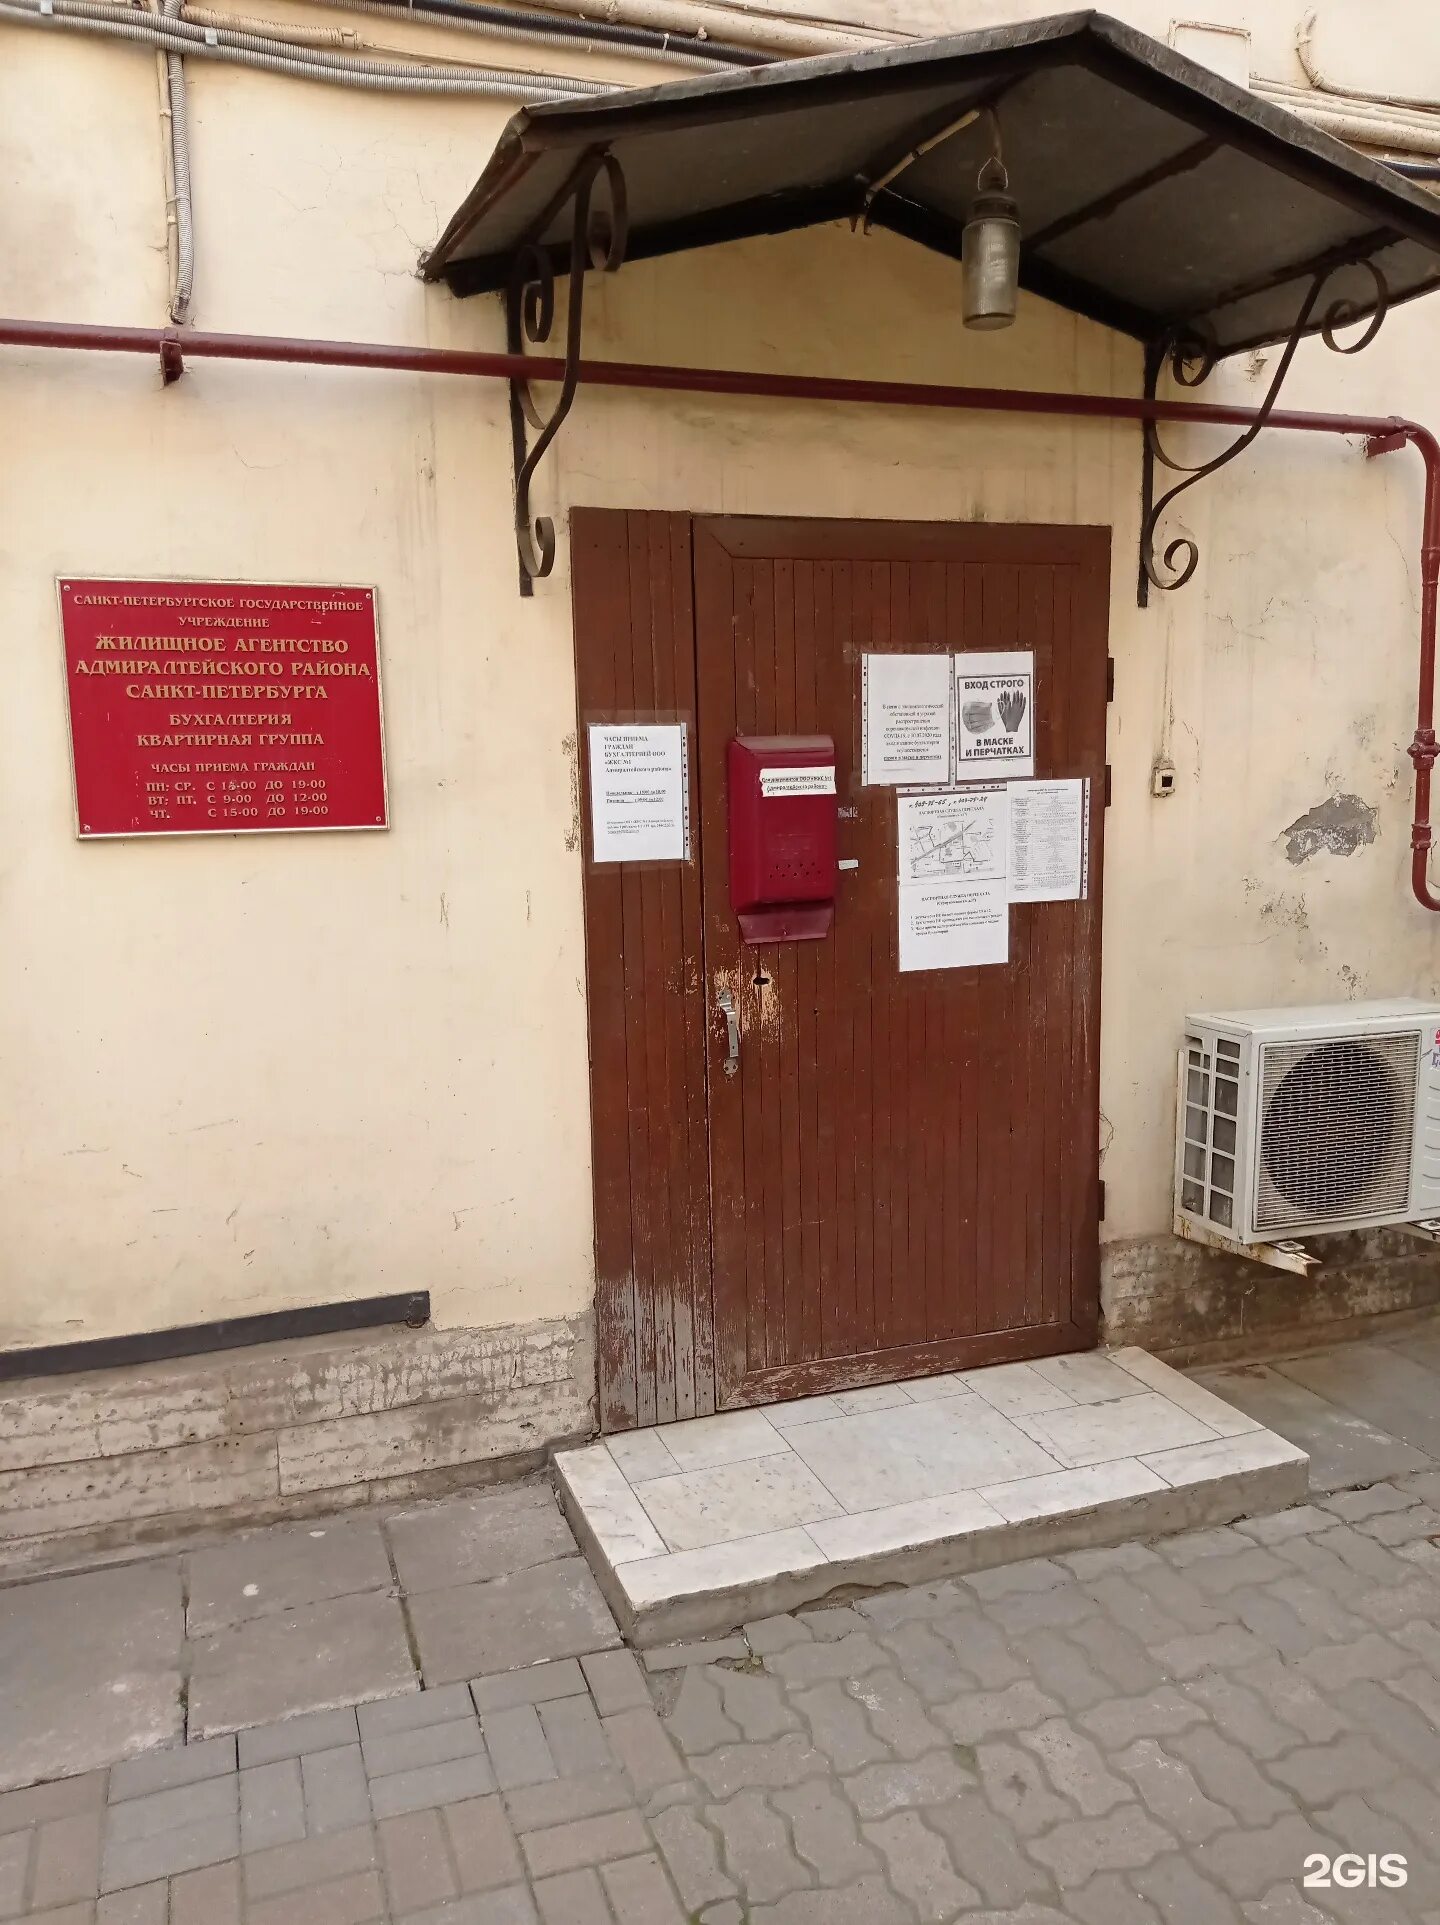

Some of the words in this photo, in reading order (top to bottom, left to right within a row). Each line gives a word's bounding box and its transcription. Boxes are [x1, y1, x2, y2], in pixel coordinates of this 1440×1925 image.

[73, 595, 235, 608] САНКТ-ПЕТЕРБУРГСКОЕ
[239, 599, 364, 611] ГОСУДАРСТВЕННОЕ
[178, 616, 270, 628] УЧРЕЖДЕНИЕ
[95, 635, 226, 653] ЖИЛИЩНОЕ
[234, 638, 349, 653] АГЕНТСТВО
[75, 659, 284, 676] АДМИРАЛТЕЙСКОГО
[291, 660, 371, 676] РАЙОНА
[964, 681, 989, 690] ВХОД
[989, 679, 1024, 689] СТРОГО
[125, 684, 329, 699] САНКТ-ПЕТЕРБУРГА
[169, 713, 292, 726] БУХГАЛТЕРИЯ
[136, 734, 252, 746] КВАРТИРНАЯ
[258, 733, 325, 745] ГРУППА
[983, 737, 1014, 746] МАСКЕ
[965, 749, 972, 757] И
[973, 746, 1025, 756] ПЕРЧАТКАХ
[151, 763, 190, 773] ЧАСЫ
[195, 762, 249, 772] ПРИЕМА
[254, 761, 315, 771] ГРАЖДАН
[206, 782, 215, 790] С
[264, 781, 283, 791] ДО
[291, 780, 326, 789] 19-00
[207, 795, 216, 804] С
[223, 795, 252, 803] 9-00
[265, 794, 284, 804] ДО
[293, 793, 327, 802] 12-00
[150, 810, 171, 819] ЧТ.
[208, 809, 217, 817] С
[223, 808, 259, 817] 15-00
[268, 808, 286, 817] ДО
[294, 806, 329, 815] 19-00
